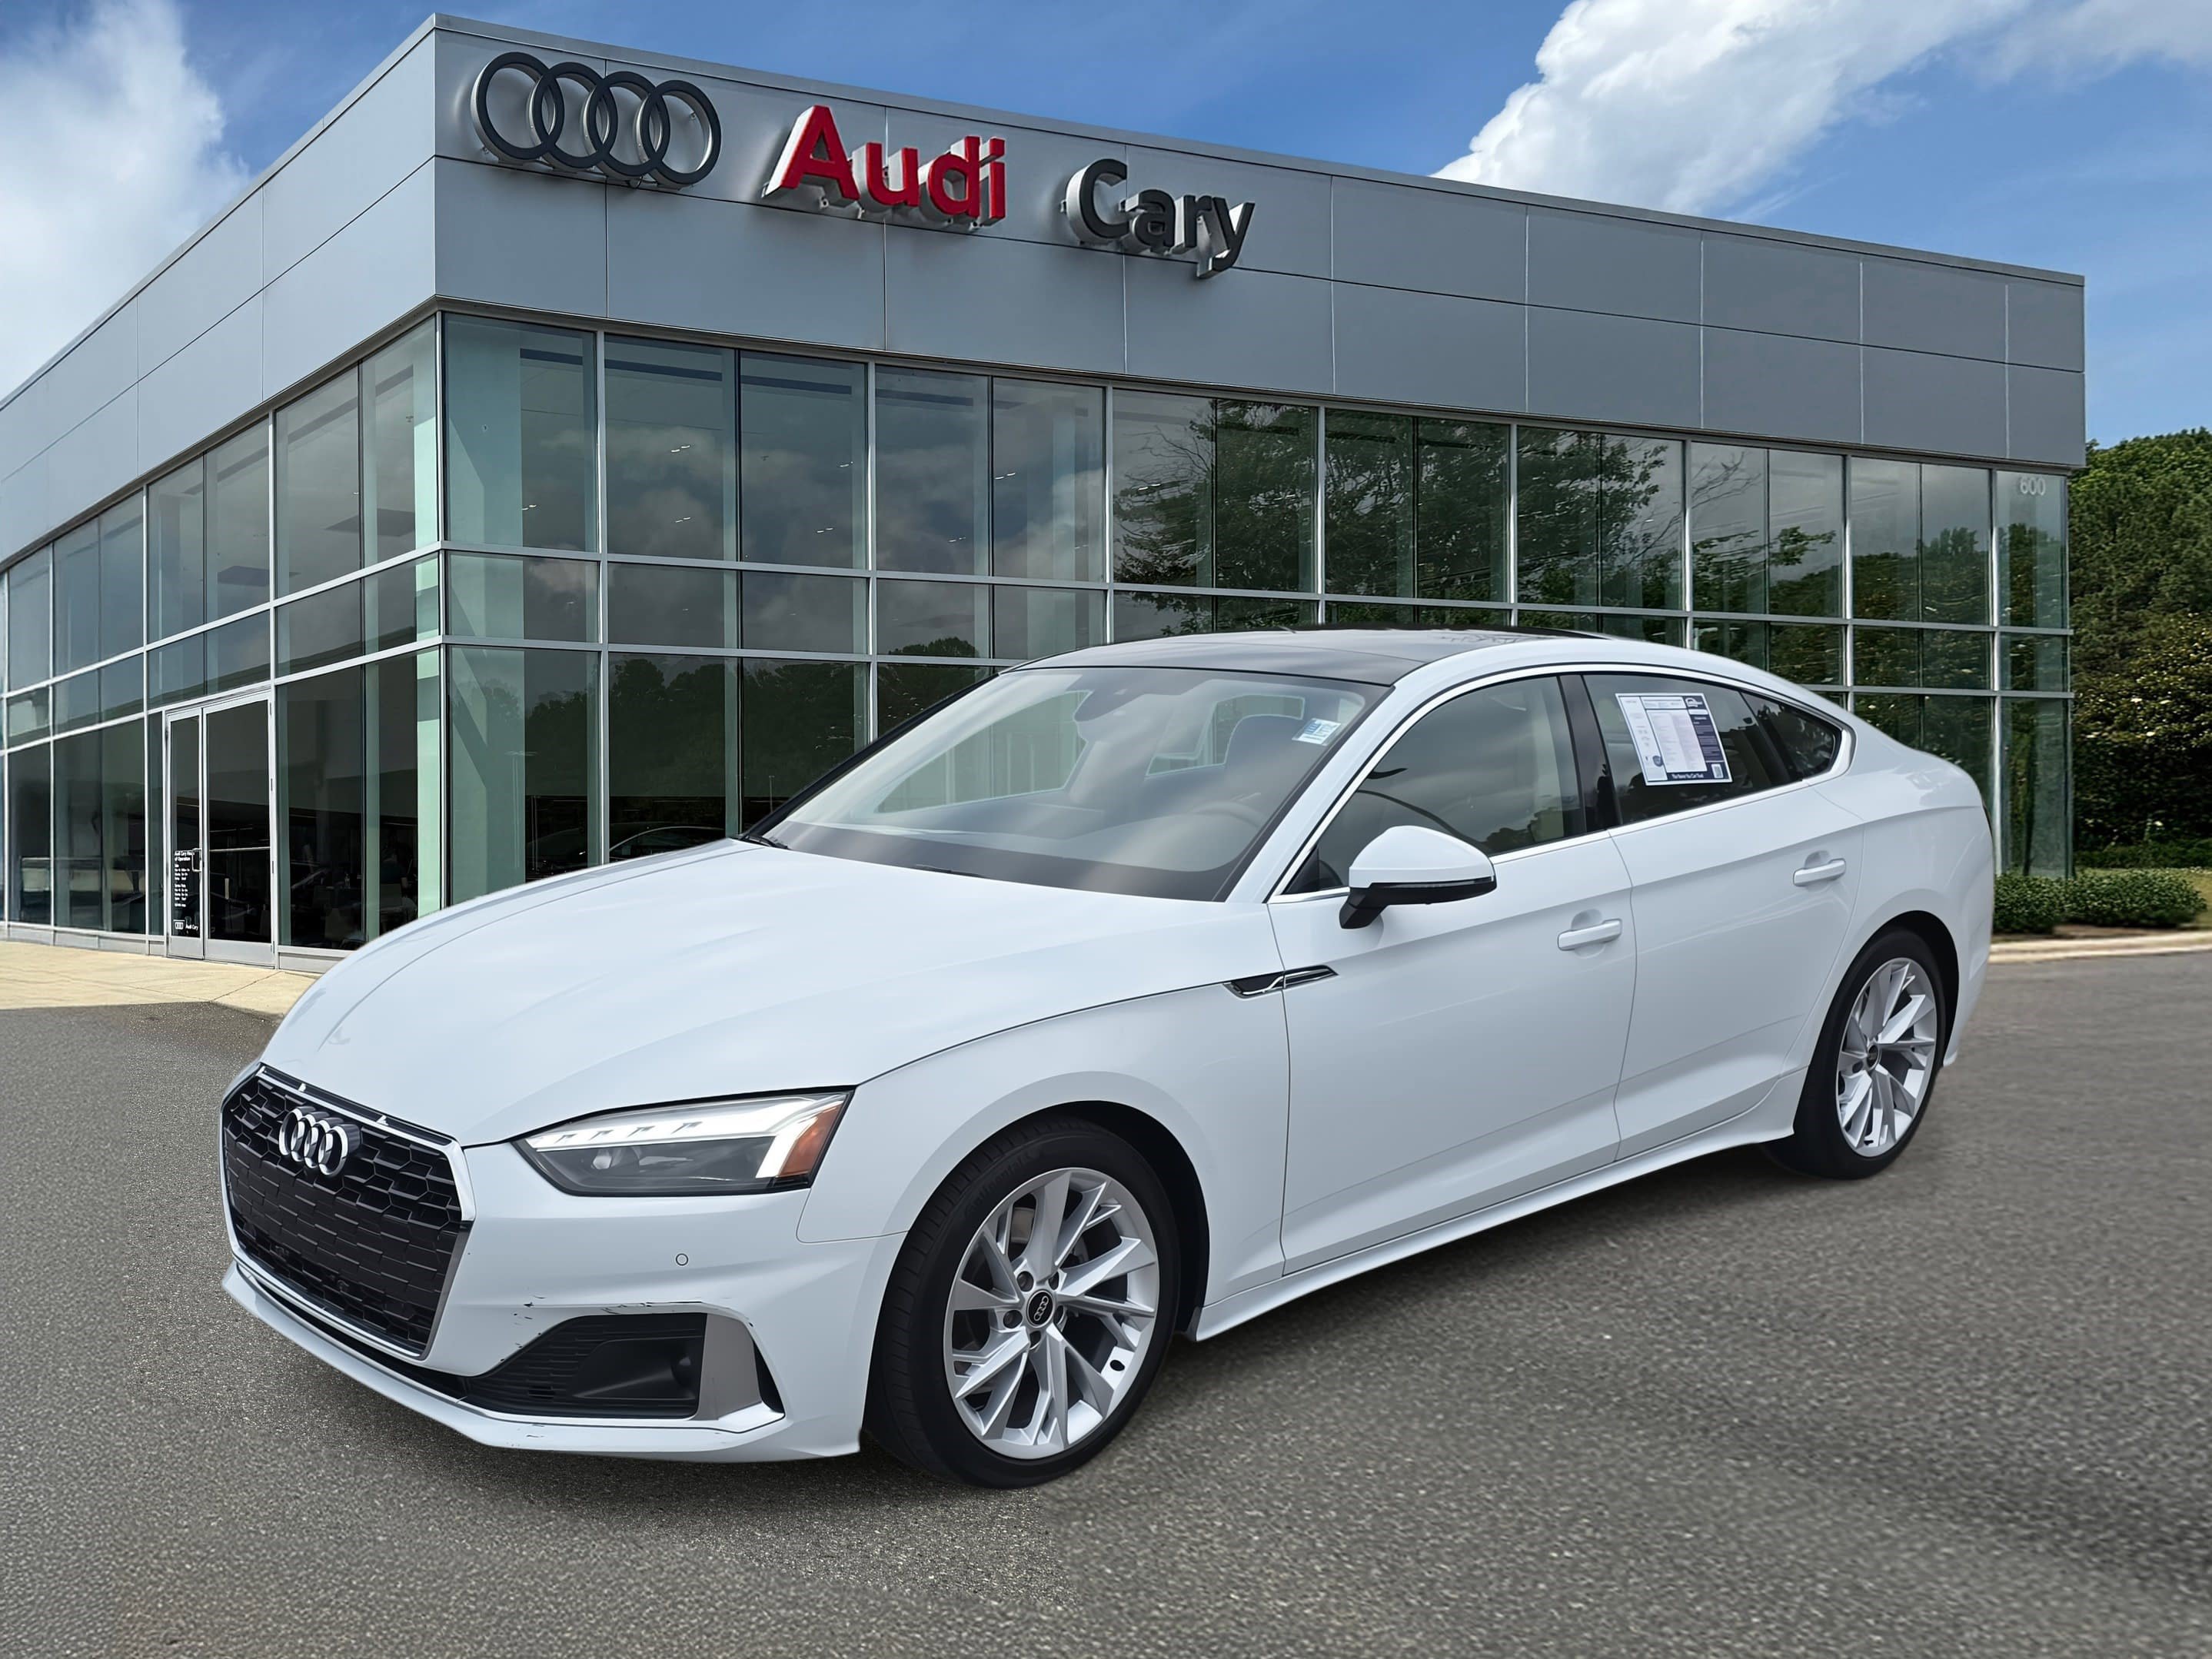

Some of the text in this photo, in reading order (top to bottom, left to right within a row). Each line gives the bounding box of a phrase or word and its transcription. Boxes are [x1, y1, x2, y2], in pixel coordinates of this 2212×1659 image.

[771, 105, 1256, 274] Audi Cary
[2020, 476, 2046, 496] 600
